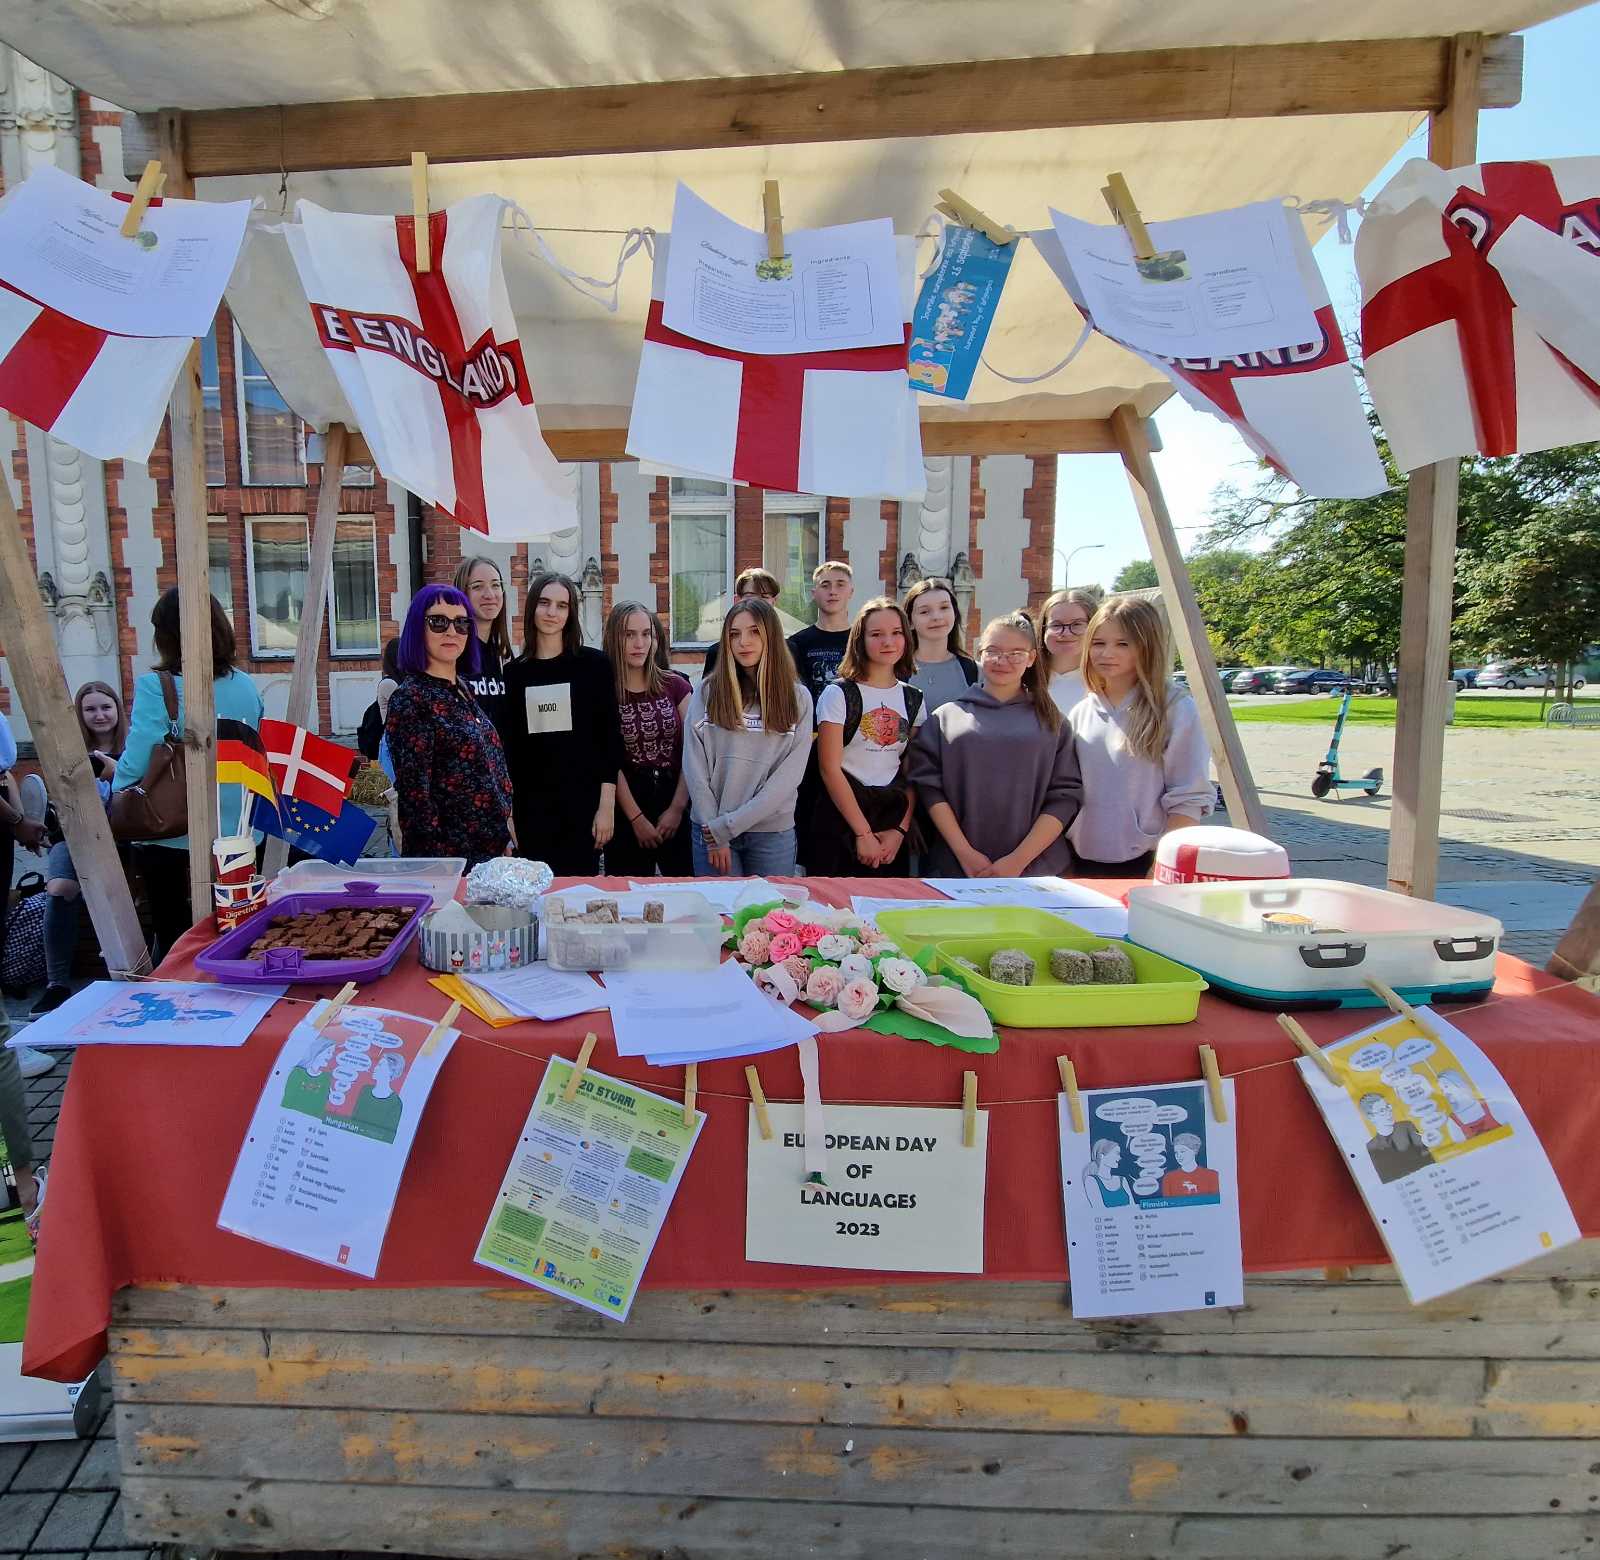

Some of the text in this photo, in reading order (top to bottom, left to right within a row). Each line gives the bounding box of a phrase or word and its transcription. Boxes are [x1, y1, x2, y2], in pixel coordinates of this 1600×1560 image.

[783, 1133, 937, 1152] EUOPEAN DAY
[846, 1163, 873, 1179] OF
[800, 1189, 917, 1209] LANGUAGES
[835, 1221, 880, 1236] 2023
